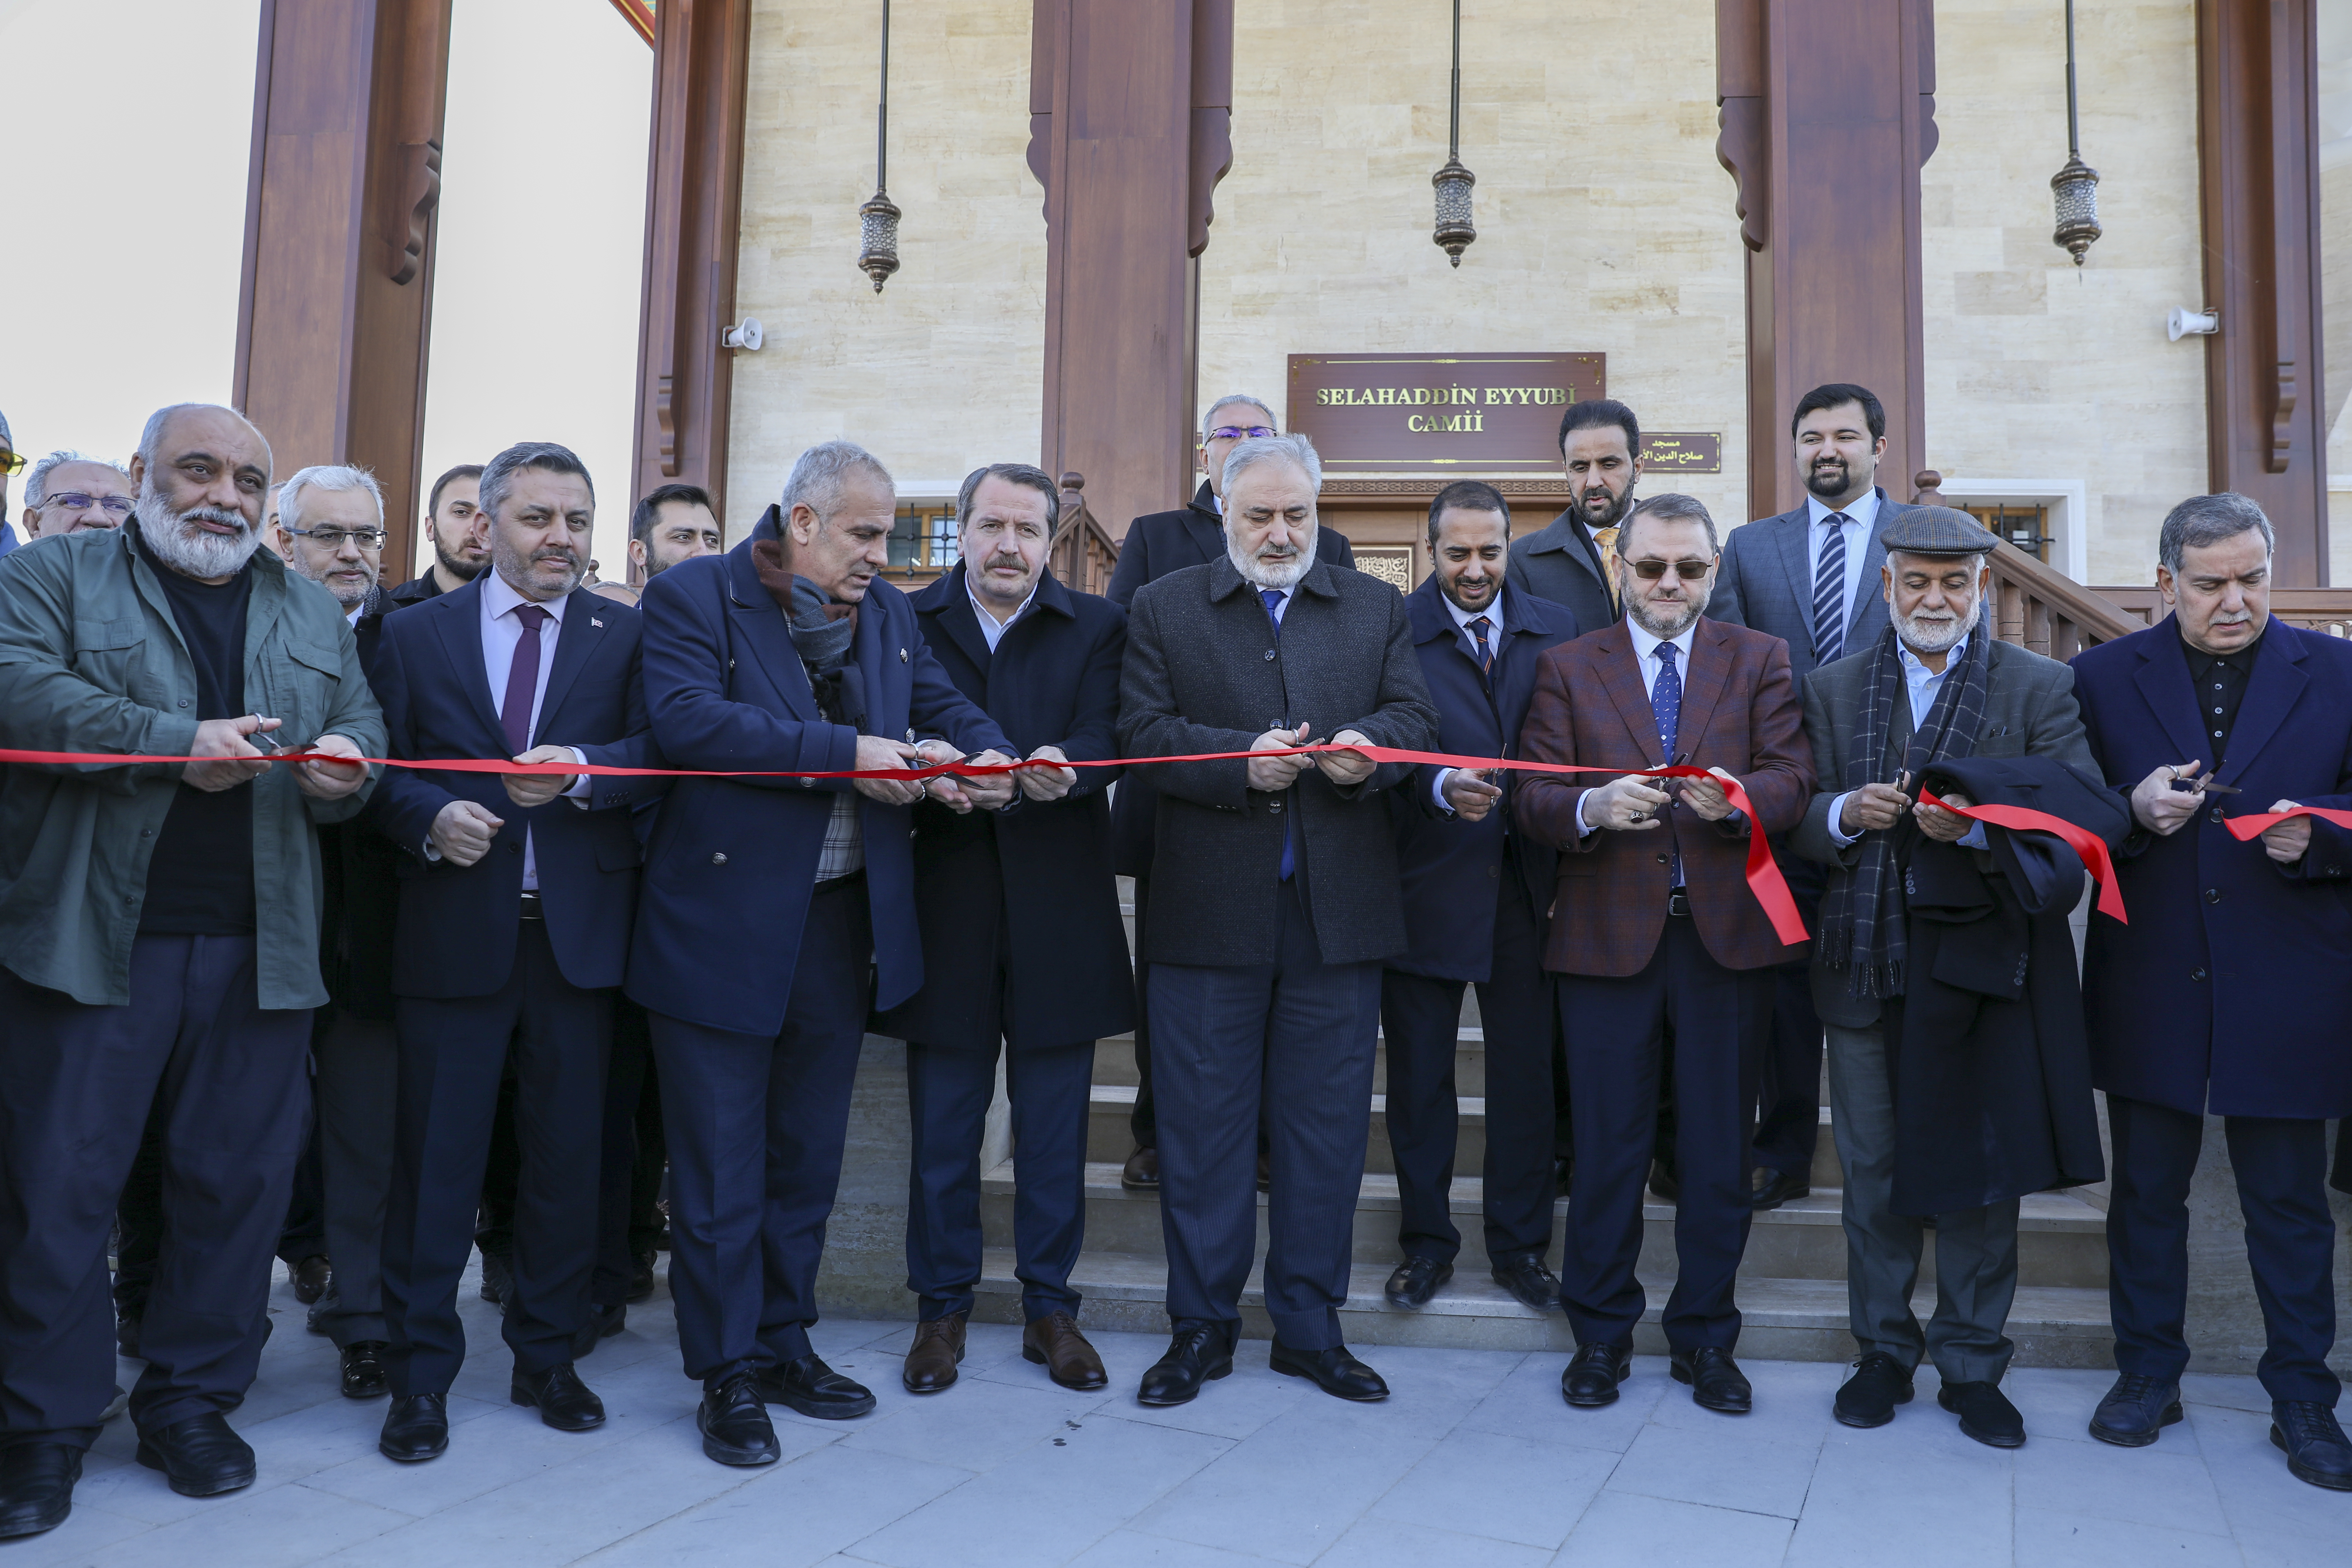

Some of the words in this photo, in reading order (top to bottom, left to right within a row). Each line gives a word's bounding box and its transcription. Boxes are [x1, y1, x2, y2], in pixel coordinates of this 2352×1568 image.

[1316, 383, 1478, 405] SELAHADDİN
[1484, 383, 1577, 405] EYYUBİ
[1408, 410, 1484, 432] CAMİİ
[1652, 439, 1681, 449] مسجد
[1654, 450, 1677, 462] الدين
[1678, 450, 1704, 464] صلاح
